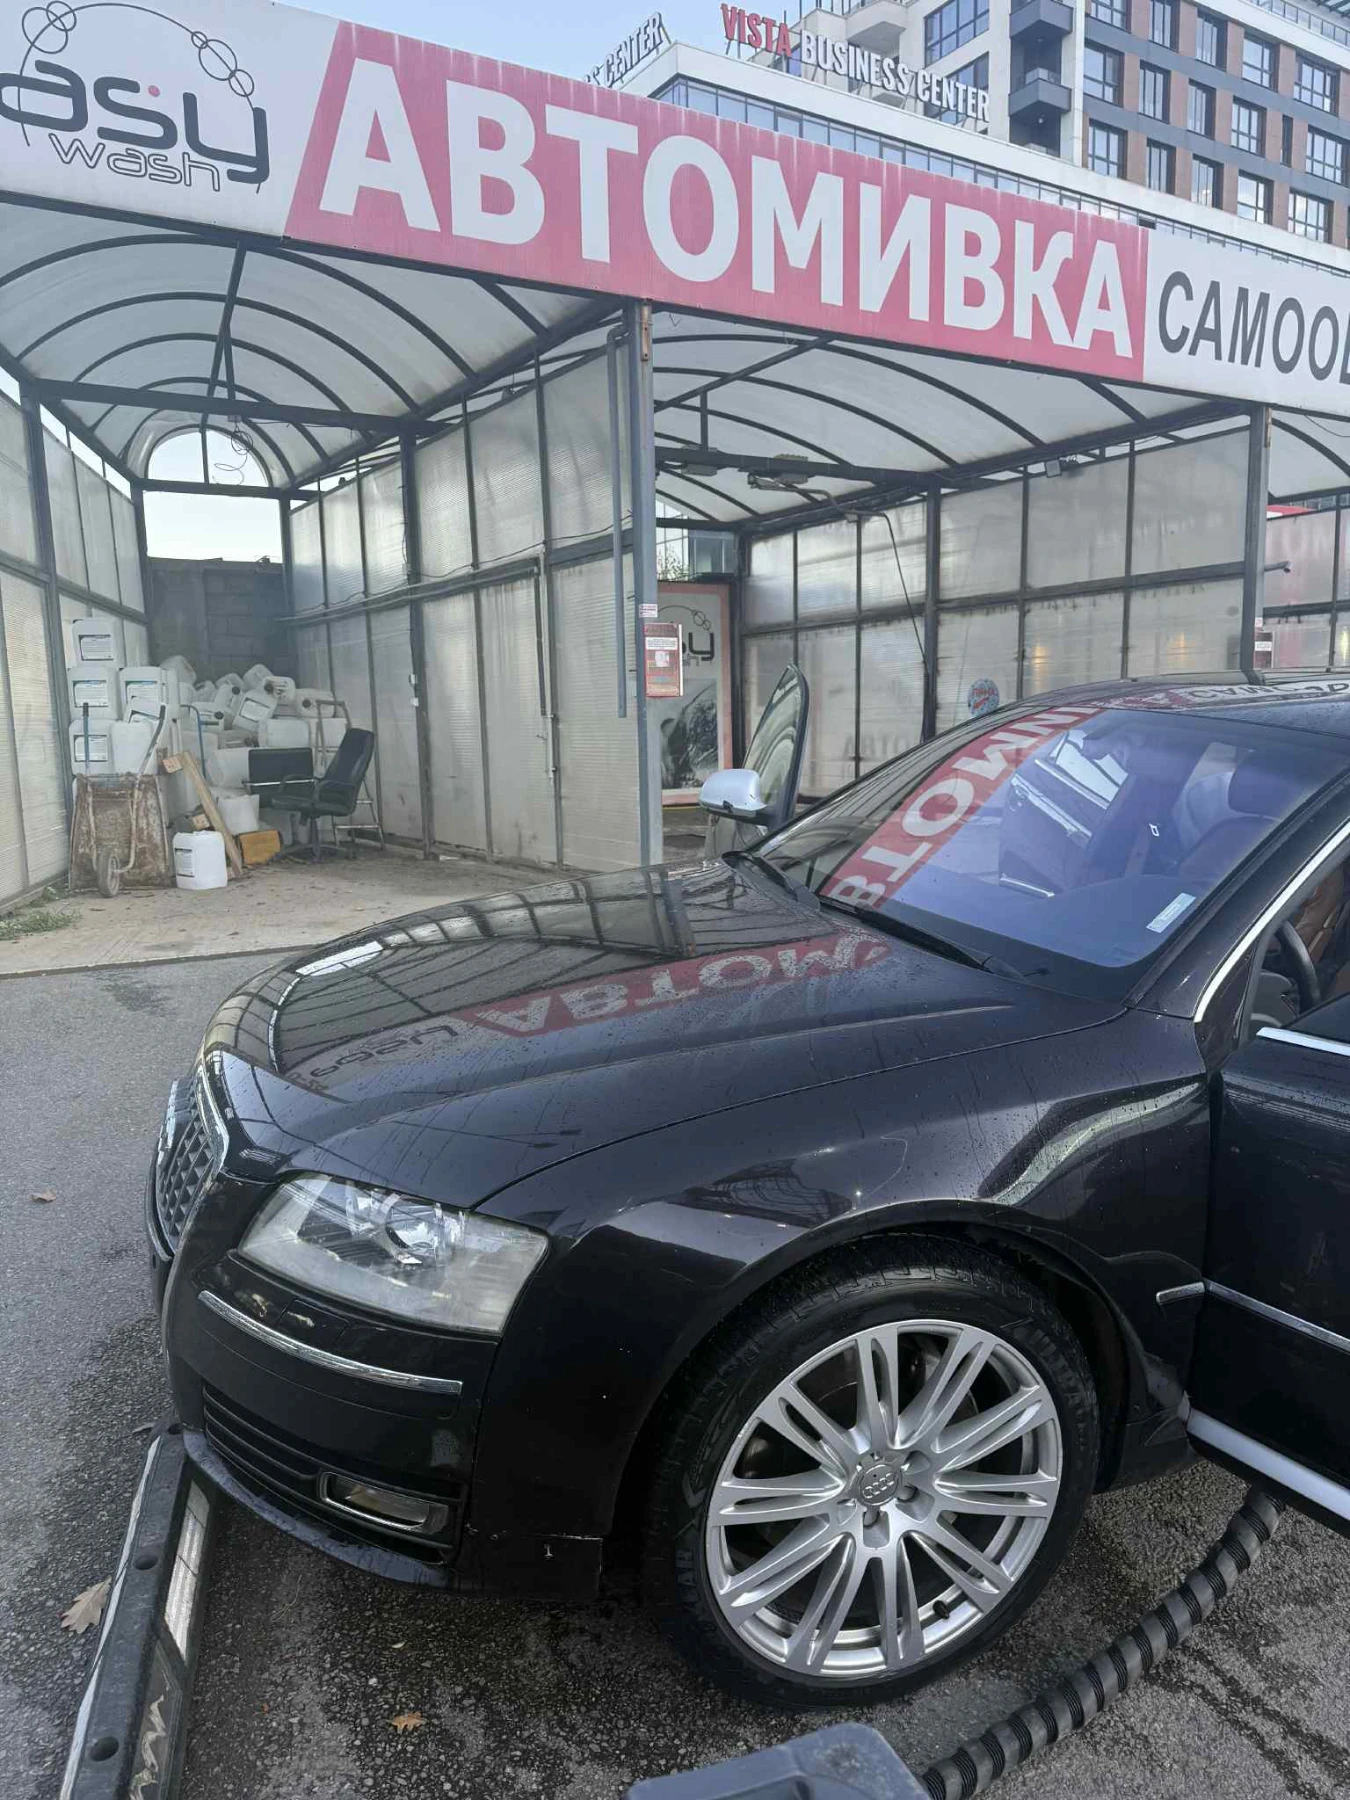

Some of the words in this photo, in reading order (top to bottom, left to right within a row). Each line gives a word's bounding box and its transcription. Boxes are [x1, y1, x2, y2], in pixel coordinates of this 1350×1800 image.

[604, 12, 664, 88] CENTER
[720, 4, 793, 58] VISTA
[801, 29, 909, 97] BUSINESS
[916, 68, 990, 122] CENTER
[48, 132, 221, 192] wash
[319, 58, 1134, 359] АВТОМИВКА
